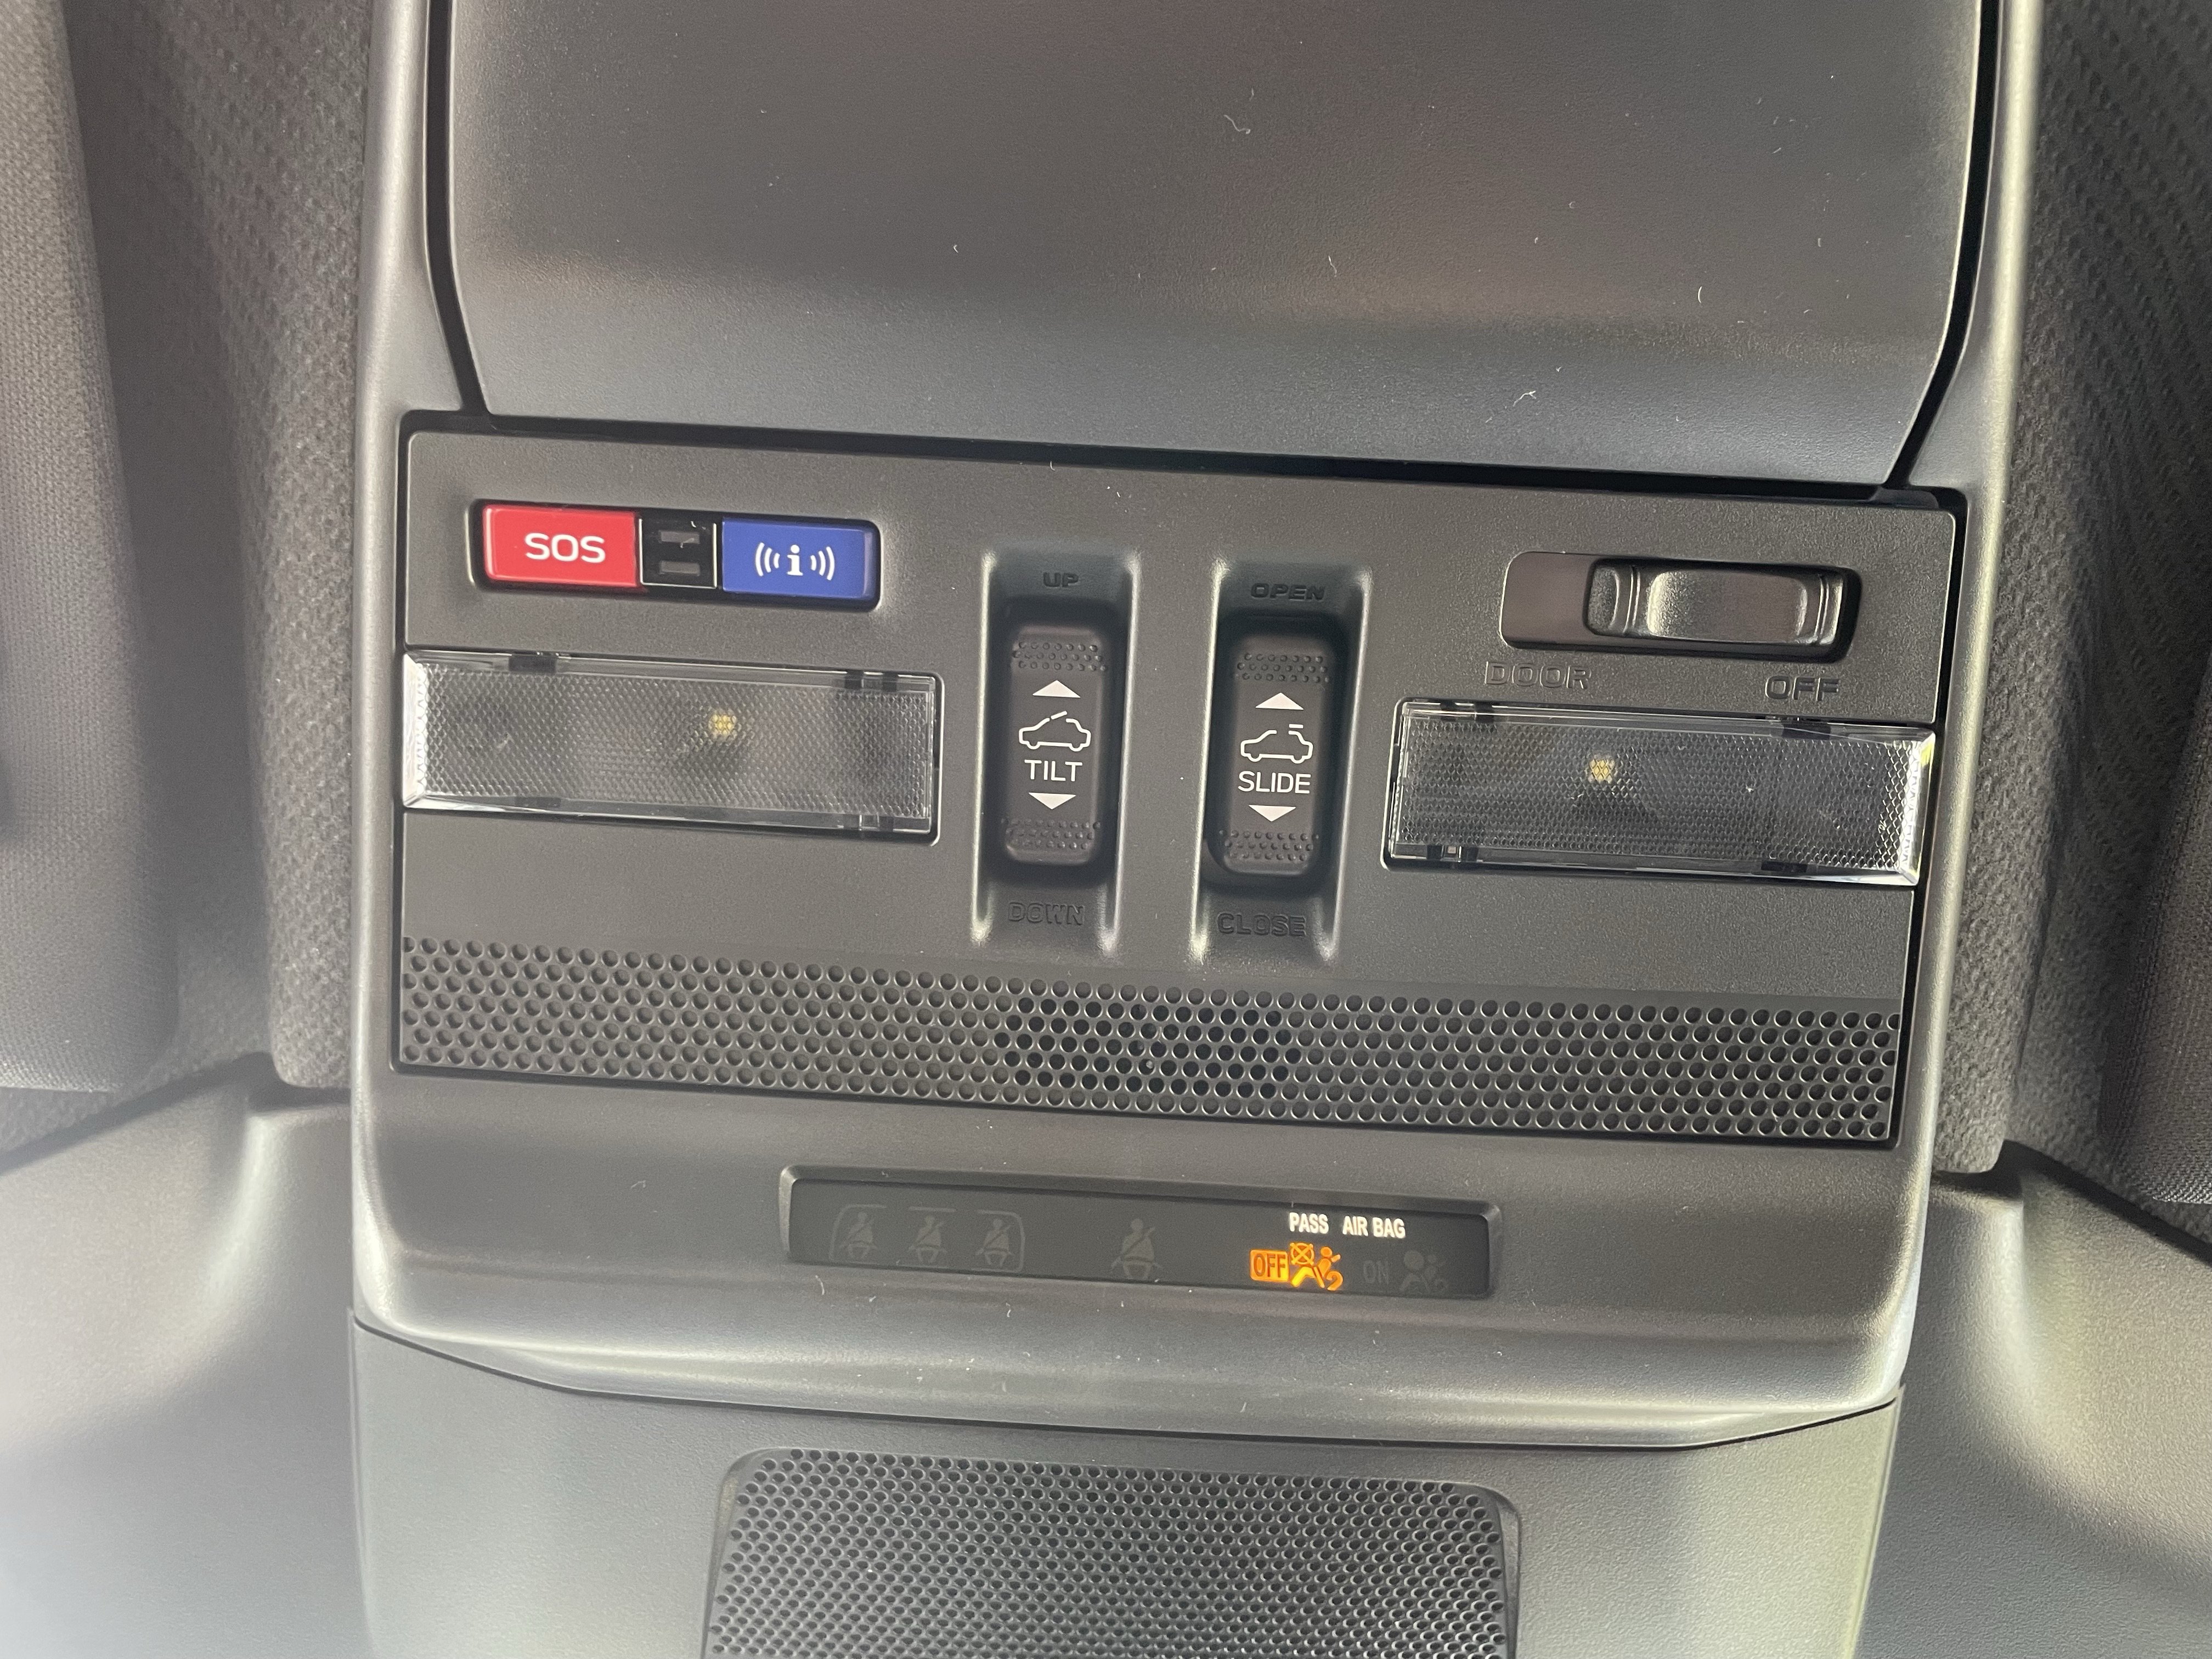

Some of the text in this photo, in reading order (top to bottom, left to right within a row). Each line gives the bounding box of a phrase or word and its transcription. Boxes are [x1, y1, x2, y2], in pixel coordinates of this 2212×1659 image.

[525, 533, 606, 563] SOS
[1043, 572, 1079, 589] UP
[1250, 583, 1326, 601] OPEN
[1485, 661, 1592, 689] DOOR
[1765, 675, 1839, 702] OFF
[1024, 759, 1083, 782] TILT
[1238, 771, 1311, 795] SLIDE
[1008, 901, 1086, 926] DOWN
[1217, 912, 1308, 937] CLOSE
[1289, 1211, 1406, 1239] PASS AIR BAG
[1253, 1251, 1286, 1279] OFF
[1362, 1261, 1389, 1284] ON
